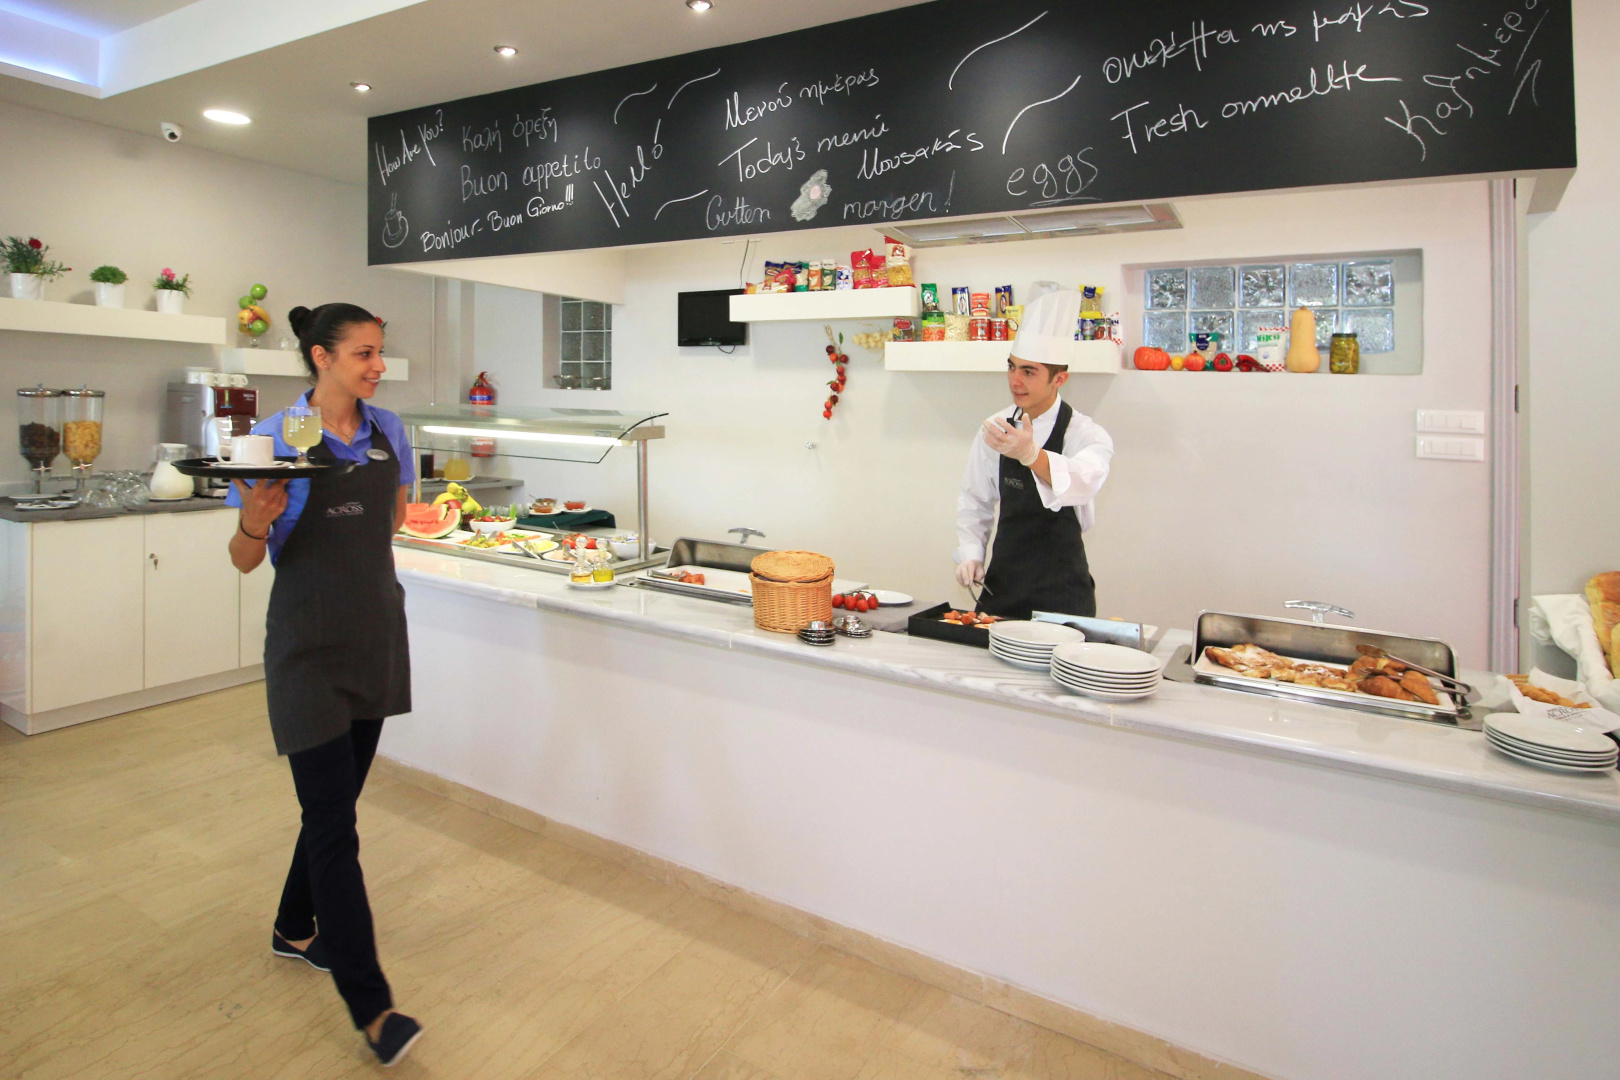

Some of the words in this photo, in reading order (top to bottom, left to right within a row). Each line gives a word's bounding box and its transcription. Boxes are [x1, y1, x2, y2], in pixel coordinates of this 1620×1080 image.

[375, 141, 401, 186] How
[400, 128, 422, 165] Are
[417, 108, 444, 167] You?
[1110, 100, 1209, 154] Fresh
[460, 164, 508, 204] Buon
[522, 146, 601, 193] appetito
[1006, 147, 1098, 199] eggs
[486, 210, 523, 232] Buon
